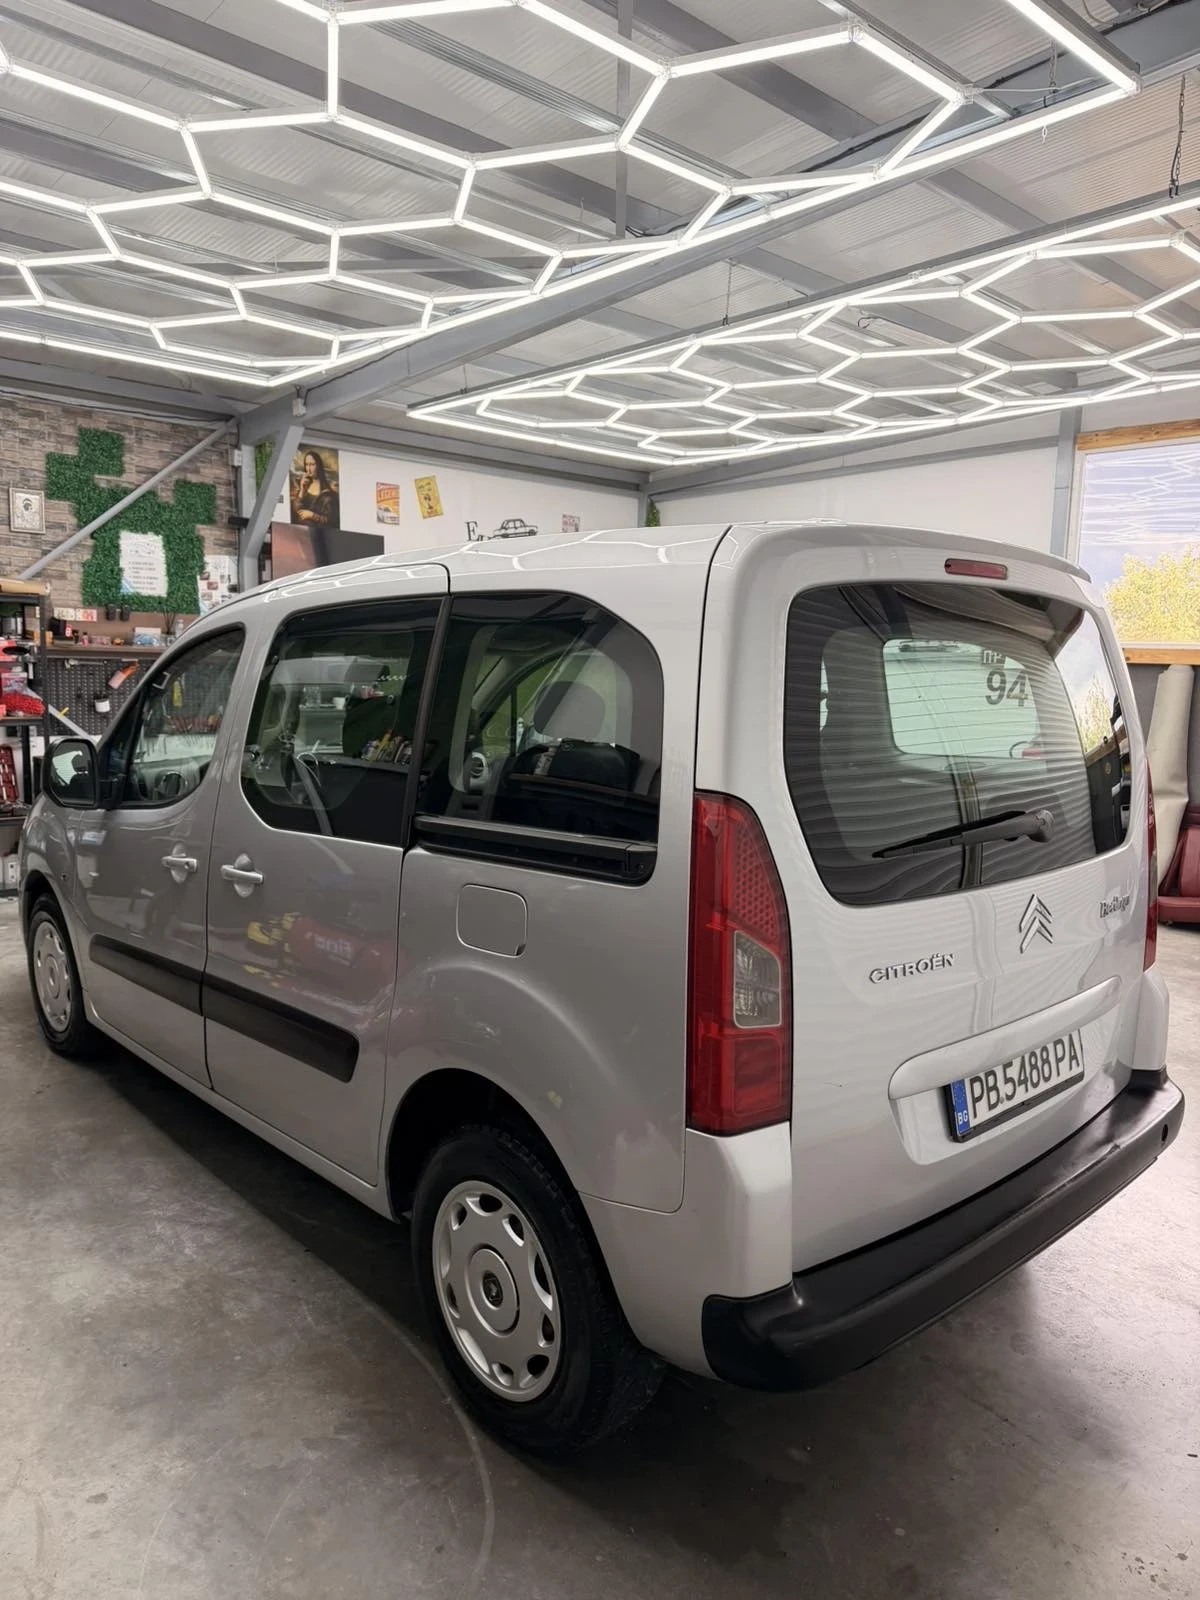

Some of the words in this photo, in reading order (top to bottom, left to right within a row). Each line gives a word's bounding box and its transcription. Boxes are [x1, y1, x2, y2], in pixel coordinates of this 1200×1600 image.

[985, 669, 1029, 706] 94
[869, 953, 955, 984] CITROËN
[957, 1111, 969, 1125] BG
